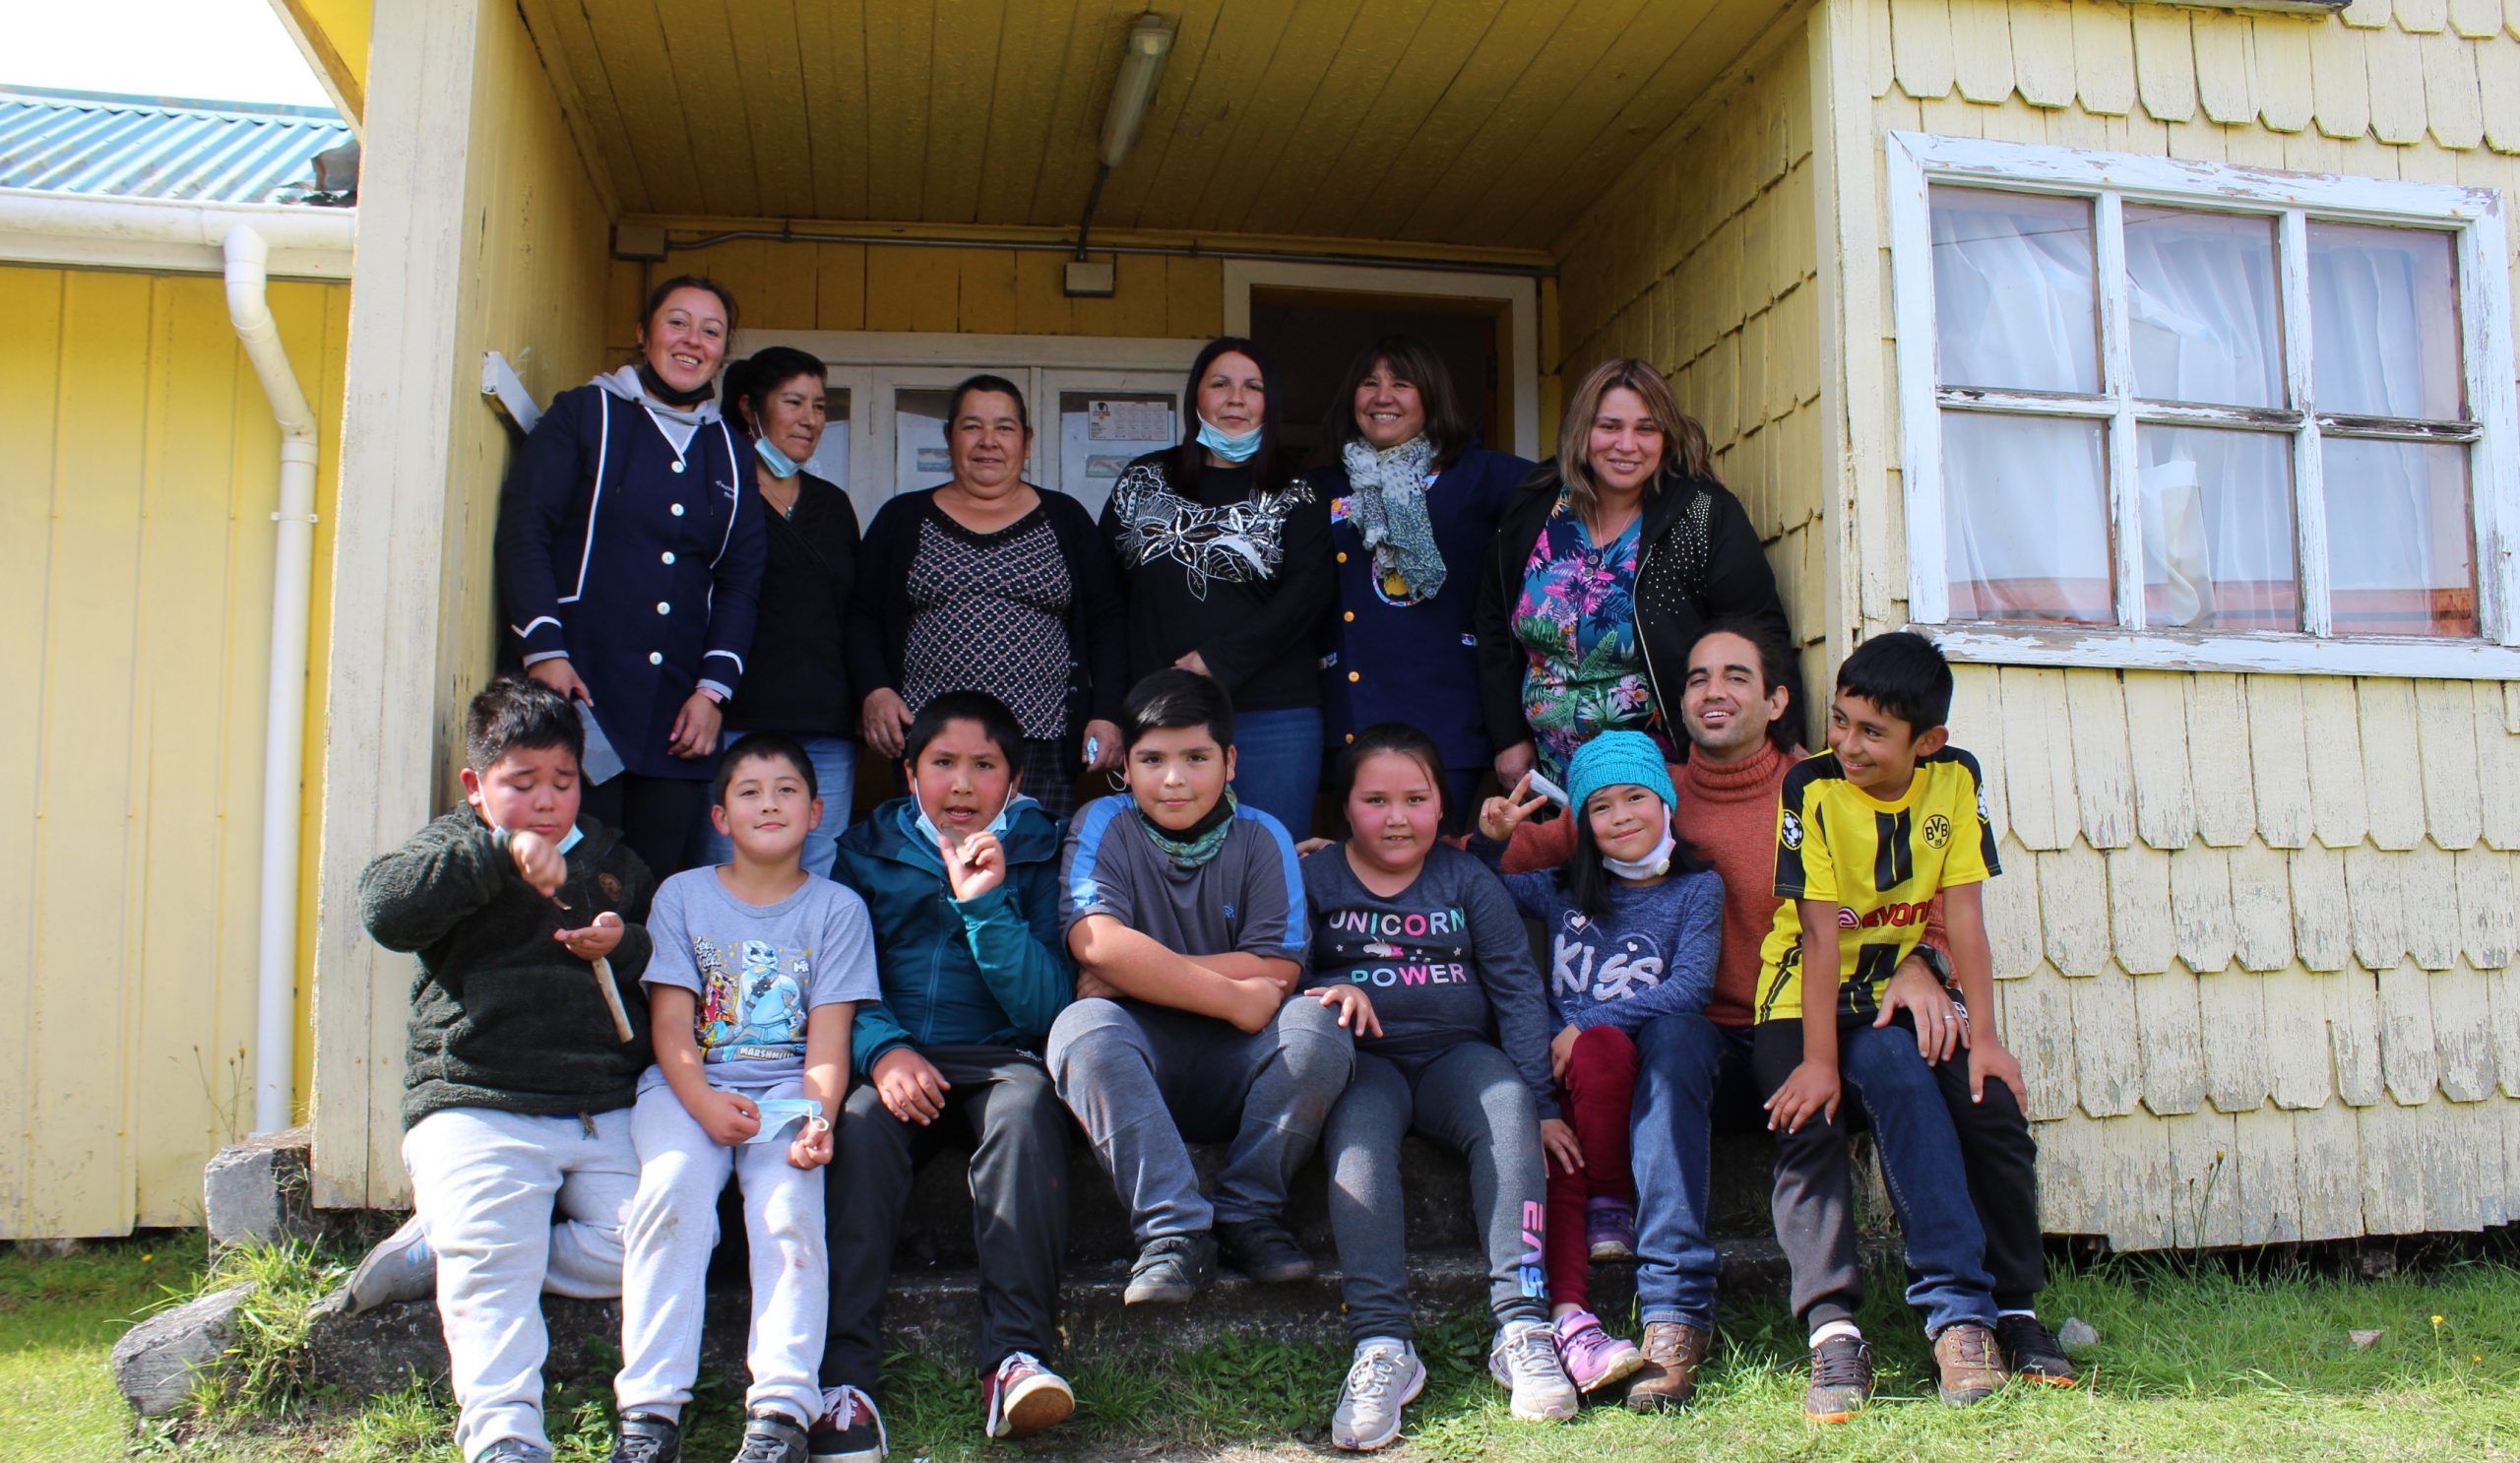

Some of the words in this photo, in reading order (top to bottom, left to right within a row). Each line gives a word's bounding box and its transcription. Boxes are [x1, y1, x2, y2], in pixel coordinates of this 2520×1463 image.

[1924, 817, 1948, 841] BVB
[1329, 907, 1465, 936] UNICORN
[1351, 963, 1467, 987] POWER
